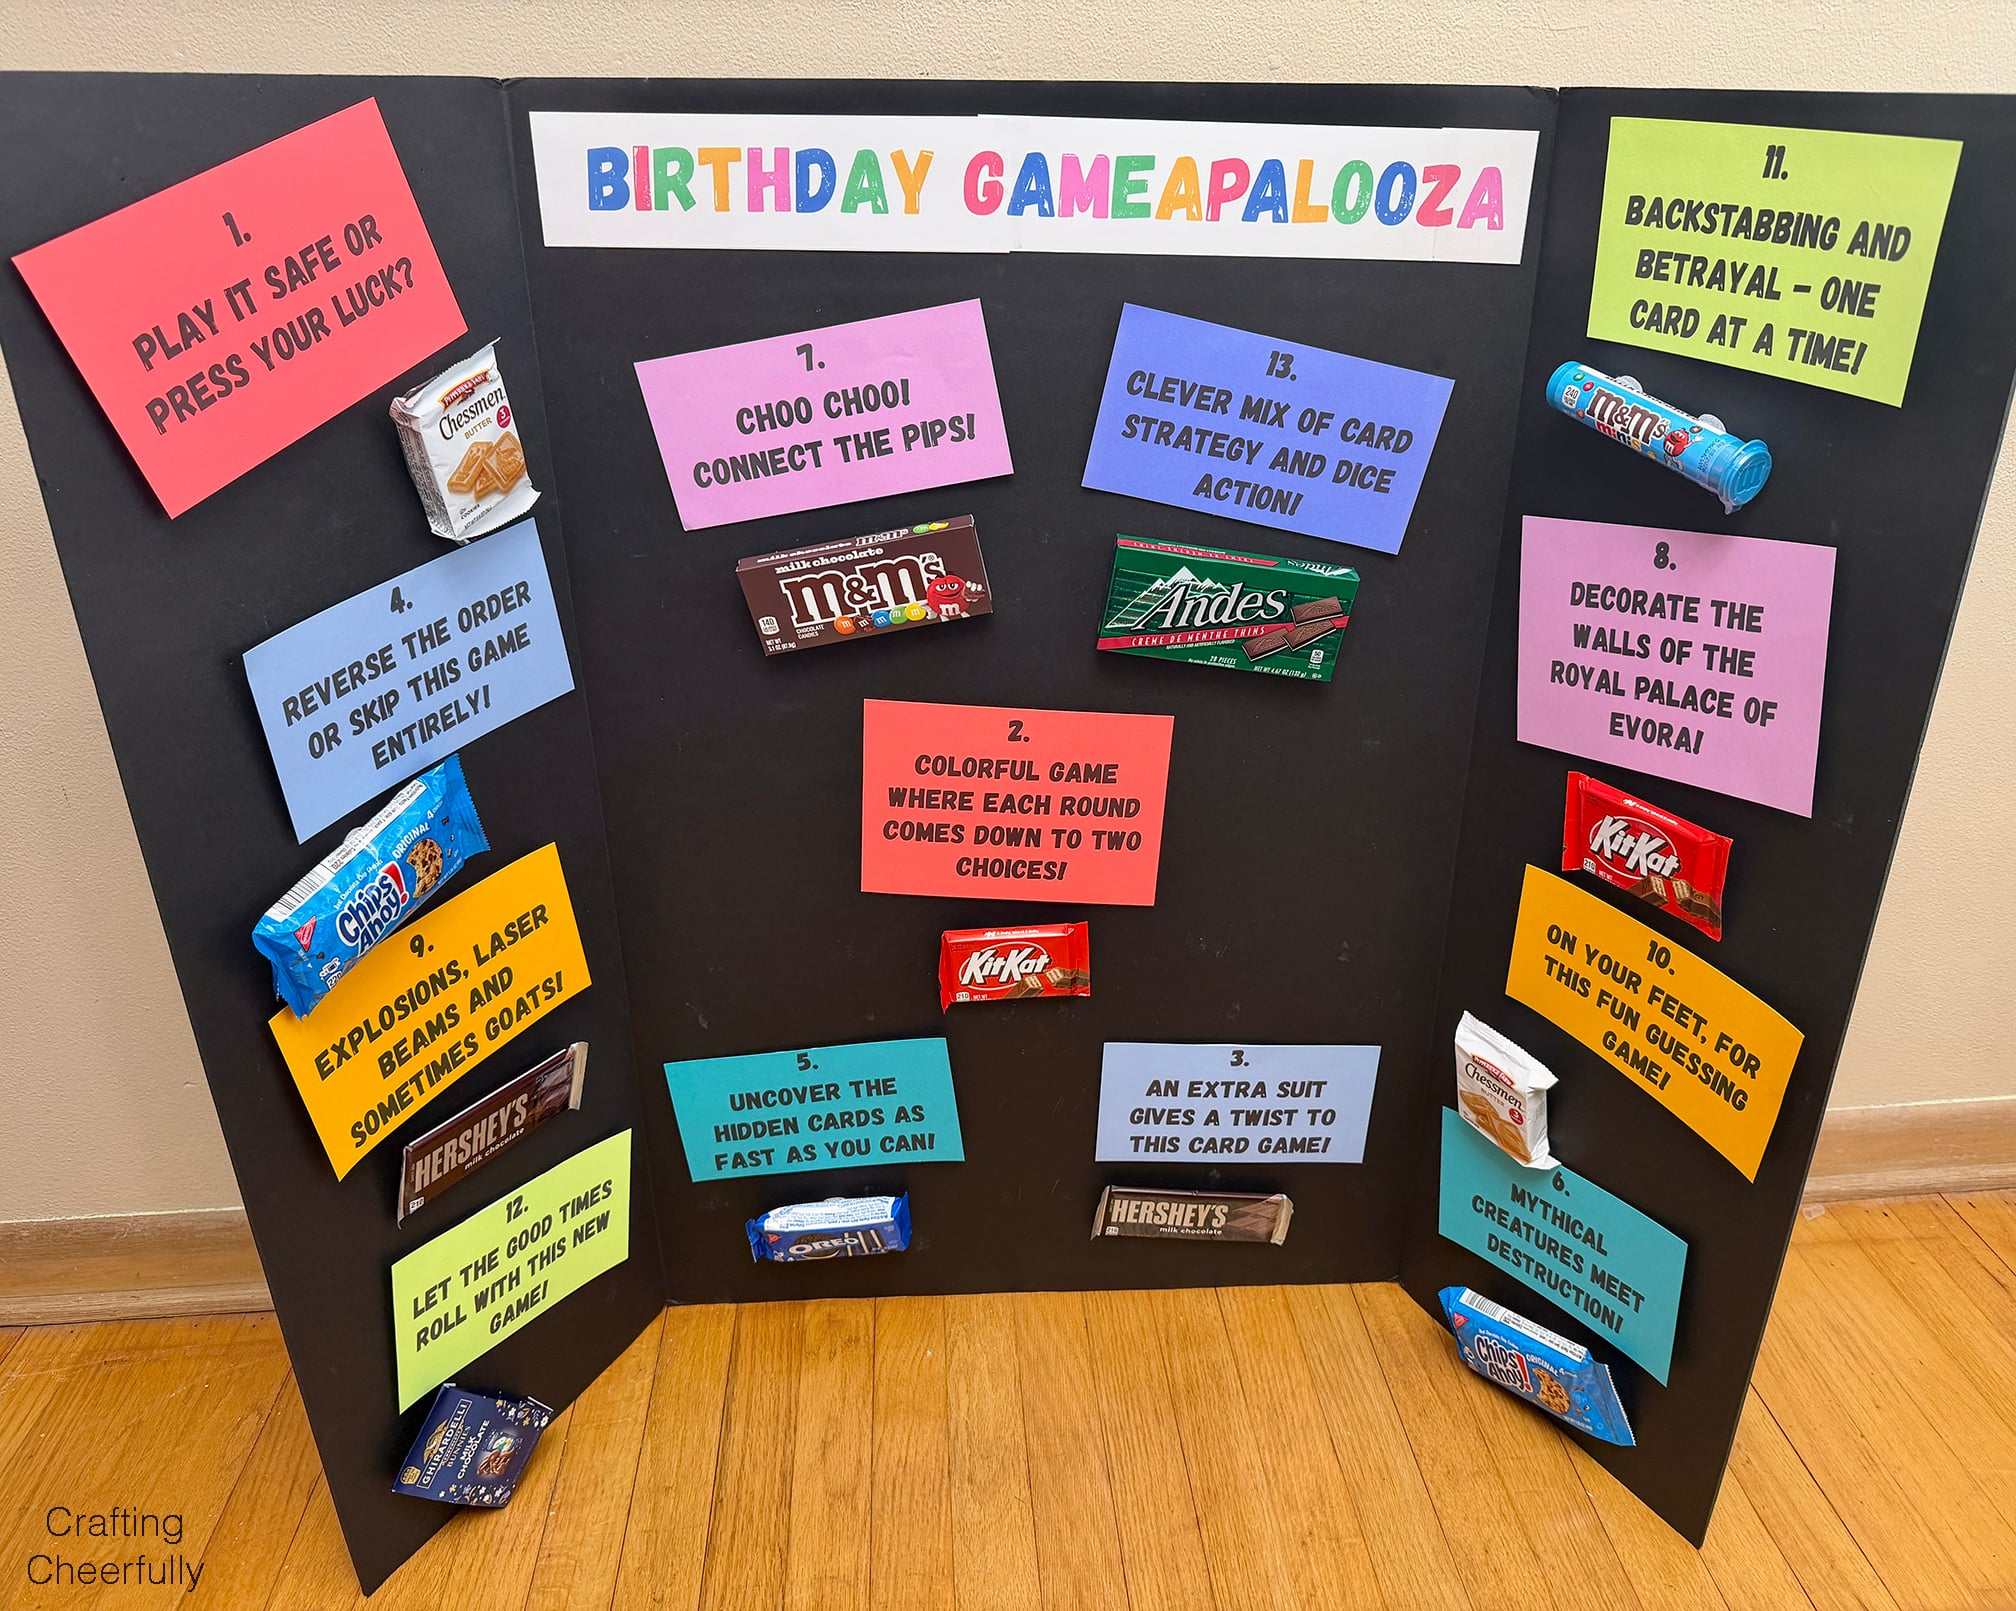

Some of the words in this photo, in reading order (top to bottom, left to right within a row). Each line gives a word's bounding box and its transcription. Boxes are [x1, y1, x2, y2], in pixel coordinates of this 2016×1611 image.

[1762, 144, 1789, 181] 11.
[586, 146, 934, 215] BIRTHDAY
[963, 150, 1504, 230] GAMEAPALOOZA
[222, 212, 252, 248] 1.
[1624, 195, 1841, 251] BACKSTABBING
[1846, 220, 1912, 262] AND
[131, 298, 220, 372] PLAY
[223, 277, 258, 322] IT
[264, 234, 342, 300] SAFE
[343, 214, 383, 257] OR
[1634, 248, 1782, 301] BETRAYAL
[1820, 276, 1882, 319] ONE
[144, 353, 250, 436] PRESS
[249, 307, 332, 372] YOUR
[330, 256, 414, 328] LUCK?
[795, 343, 826, 372] 7.
[1629, 299, 1700, 339] CARD
[1706, 314, 1748, 349] AT
[1752, 323, 1774, 357] A
[1787, 327, 1868, 376] TIME!
[1265, 350, 1297, 382] 13.
[439, 387, 502, 441] Chessmen
[736, 396, 813, 435] CHOO
[823, 378, 911, 419] CHOO!
[1126, 370, 1233, 416] CLEVER
[1238, 394, 1291, 429] MIX
[1297, 407, 1335, 437] OF
[1340, 417, 1414, 454] CARD
[1565, 386, 1579, 400] 240
[464, 416, 493, 439] BUTTER
[1595, 420, 1643, 452] minis
[693, 439, 823, 489] CONNECT
[832, 427, 894, 464] THE
[901, 413, 976, 452] PIPS!
[1121, 413, 1265, 466] STRATEGY
[1268, 446, 1327, 479] AND
[1331, 459, 1397, 494] DICE
[1192, 473, 1304, 517] ACTION!
[775, 557, 812, 575] milk
[811, 546, 884, 568] chocolate
[1653, 541, 1677, 571] 8.
[390, 586, 413, 614] 4.
[1131, 582, 1287, 630] Andes
[1570, 581, 1701, 624] DECORATE
[1710, 599, 1764, 633] THE
[282, 643, 397, 727] REVERSE
[401, 616, 451, 660] THE
[457, 580, 532, 633] ORDER
[1169, 634, 1182, 644] DE
[1187, 629, 1228, 642] MENTHE
[1234, 625, 1266, 639] THINS
[1573, 623, 1651, 659] WALLS
[1659, 637, 1693, 666] OF
[1702, 643, 1756, 678] THE
[308, 722, 343, 760] OR
[349, 688, 400, 736] SKIP
[406, 657, 461, 703] THIS
[467, 622, 531, 673] GAME
[1550, 660, 1626, 697] ROYAL
[1634, 676, 1735, 719] PALACE
[1743, 696, 1778, 728] OF
[371, 684, 491, 770] ENTIRELY!
[1007, 719, 1030, 743] 2.
[1609, 711, 1705, 755] EVORA!
[914, 754, 1040, 781] COLORFUL
[1048, 761, 1119, 784] GAME
[888, 787, 975, 812] WHERE
[982, 792, 1052, 816] EACH
[1059, 796, 1141, 819] ROUND
[392, 821, 431, 859] ORIGINAL
[882, 820, 965, 844] COMES
[973, 825, 1042, 848] DOWN
[1050, 828, 1082, 850] TO
[1091, 830, 1142, 852] TWO
[955, 856, 1068, 881] CHOICES!
[1584, 859, 1596, 870] 210
[337, 872, 394, 944] Chips
[409, 934, 435, 958] 9.
[1646, 939, 1676, 977] 10.
[314, 959, 469, 1082] EXPLOSIONS,
[472, 904, 549, 968] LASER
[1547, 924, 1578, 956] ON
[1585, 943, 1642, 995] YOUR
[1647, 984, 1708, 1044] FEET,
[1714, 1031, 1761, 1080] FOR
[377, 1003, 460, 1080] BEAMS
[469, 966, 513, 1015] AND
[1544, 954, 1592, 998] THIS
[1596, 988, 1641, 1032] FUN
[1645, 1023, 1749, 1112] GUESSING
[350, 1032, 479, 1149] SOMETIMES
[485, 970, 563, 1041] GOATS!
[796, 1052, 819, 1072] 5.
[1230, 1049, 1250, 1067] 3.
[1602, 1030, 1672, 1091] GAME!
[729, 1083, 841, 1112] UNCOVER
[848, 1077, 898, 1099] THE
[1145, 1079, 1180, 1098] AN
[1187, 1080, 1267, 1099] EXTRA
[1276, 1080, 1328, 1099] SUIT
[1465, 1062, 1522, 1111] Chessmen
[713, 1116, 800, 1143] HIDDEN
[807, 1107, 885, 1132] CARDS
[894, 1104, 925, 1124] AS
[1129, 1107, 1196, 1126] GIVES
[1203, 1109, 1220, 1127] A
[1230, 1109, 1299, 1127] TWIST
[1306, 1108, 1337, 1126] TO
[414, 1092, 529, 1193] HERSHEY'S
[464, 1154, 483, 1171] milk
[485, 1127, 525, 1157] chocolate
[714, 1148, 775, 1171] FAST
[786, 1144, 817, 1164] AS
[824, 1138, 871, 1159] YOU
[879, 1132, 935, 1153] CAN!
[1129, 1135, 1181, 1153] THIS
[1188, 1136, 1250, 1154] CARD
[1257, 1136, 1332, 1154] GAME!
[1551, 1169, 1571, 1198] 6.
[506, 1195, 529, 1224] 12.
[1110, 1199, 1229, 1228] HERSHEY'S
[1159, 1226, 1178, 1234] milk
[1180, 1227, 1223, 1235] chocolate
[1510, 1183, 1608, 1257] MYTHICAL
[413, 1276, 452, 1320] LET
[459, 1246, 499, 1288] THE
[506, 1214, 553, 1259] GOOD
[559, 1179, 612, 1224] TIMES
[788, 1236, 860, 1254] OREO
[1471, 1194, 1584, 1274] CREATURES
[1590, 1263, 1645, 1314] MEET
[416, 1304, 467, 1353] ROLL
[474, 1265, 521, 1314] WITH
[527, 1236, 566, 1277] THIS
[572, 1210, 611, 1249] NEW
[1487, 1233, 1624, 1334] DESTRUCTION!
[489, 1279, 549, 1335] GAME!
[1476, 1336, 1518, 1369] Chips
[1525, 1353, 1560, 1377] ORIGINAL
[422, 1403, 468, 1485] GHIRARDELLI
[457, 1419, 490, 1480] CHOCOLATE
[459, 1436, 476, 1462] MILK
